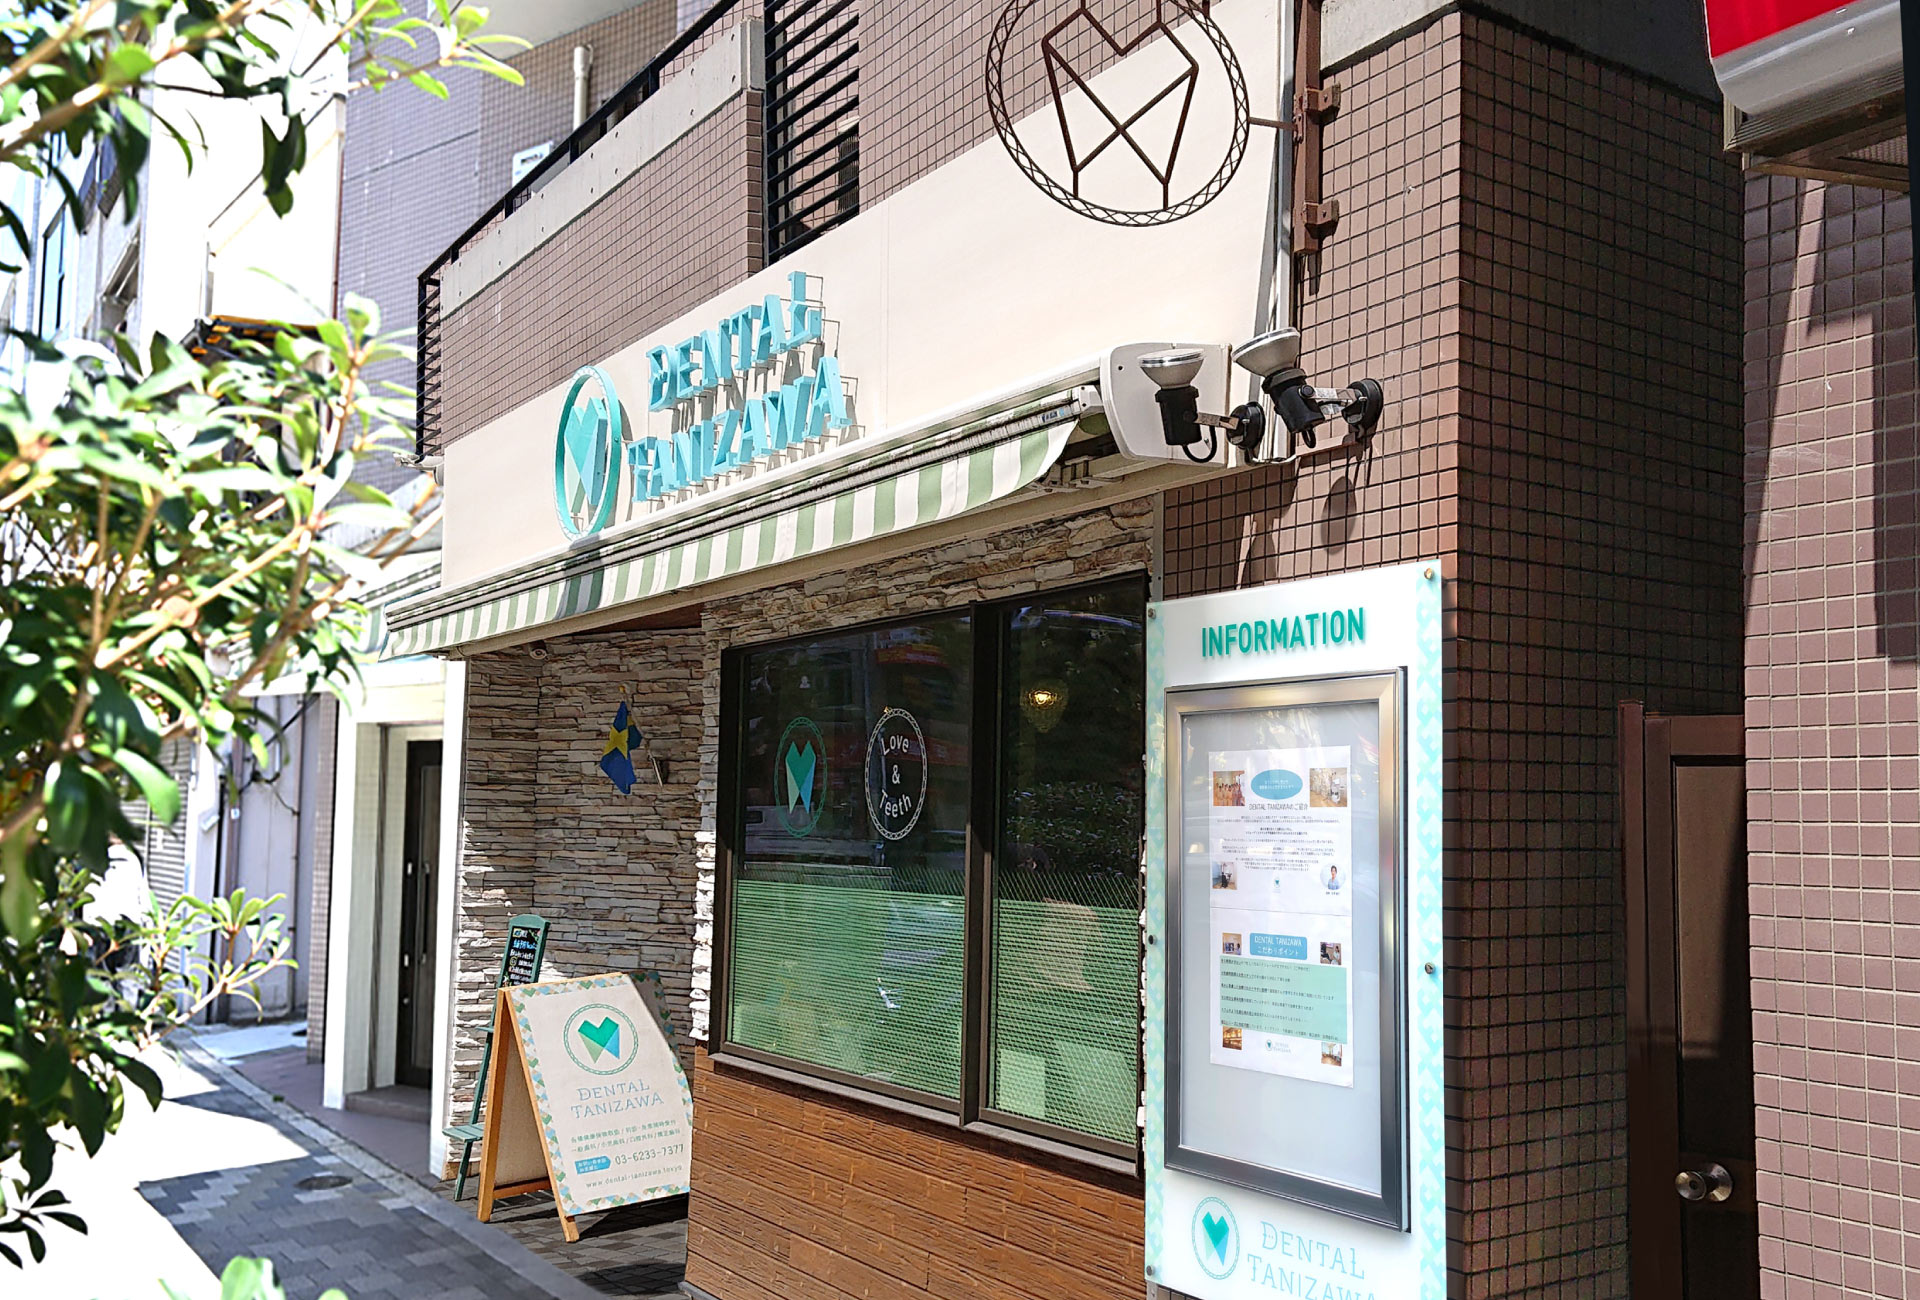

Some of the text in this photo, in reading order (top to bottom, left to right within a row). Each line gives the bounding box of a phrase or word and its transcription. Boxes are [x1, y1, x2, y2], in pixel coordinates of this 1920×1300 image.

[646, 271, 822, 412] DENTAL
[627, 356, 852, 503] TANIZAWA
[1201, 607, 1366, 658] INFORMATION
[881, 734, 910, 756] Love
[891, 764, 901, 785] &
[879, 789, 912, 818] Teeth
[1254, 935, 1302, 947] DENTAL TANIZAWA
[577, 1079, 650, 1101] DENTAL
[570, 1092, 664, 1119] TANIZAWA
[615, 1143, 684, 1165] 03-6233-7377
[1260, 1221, 1365, 1280] DENTAL
